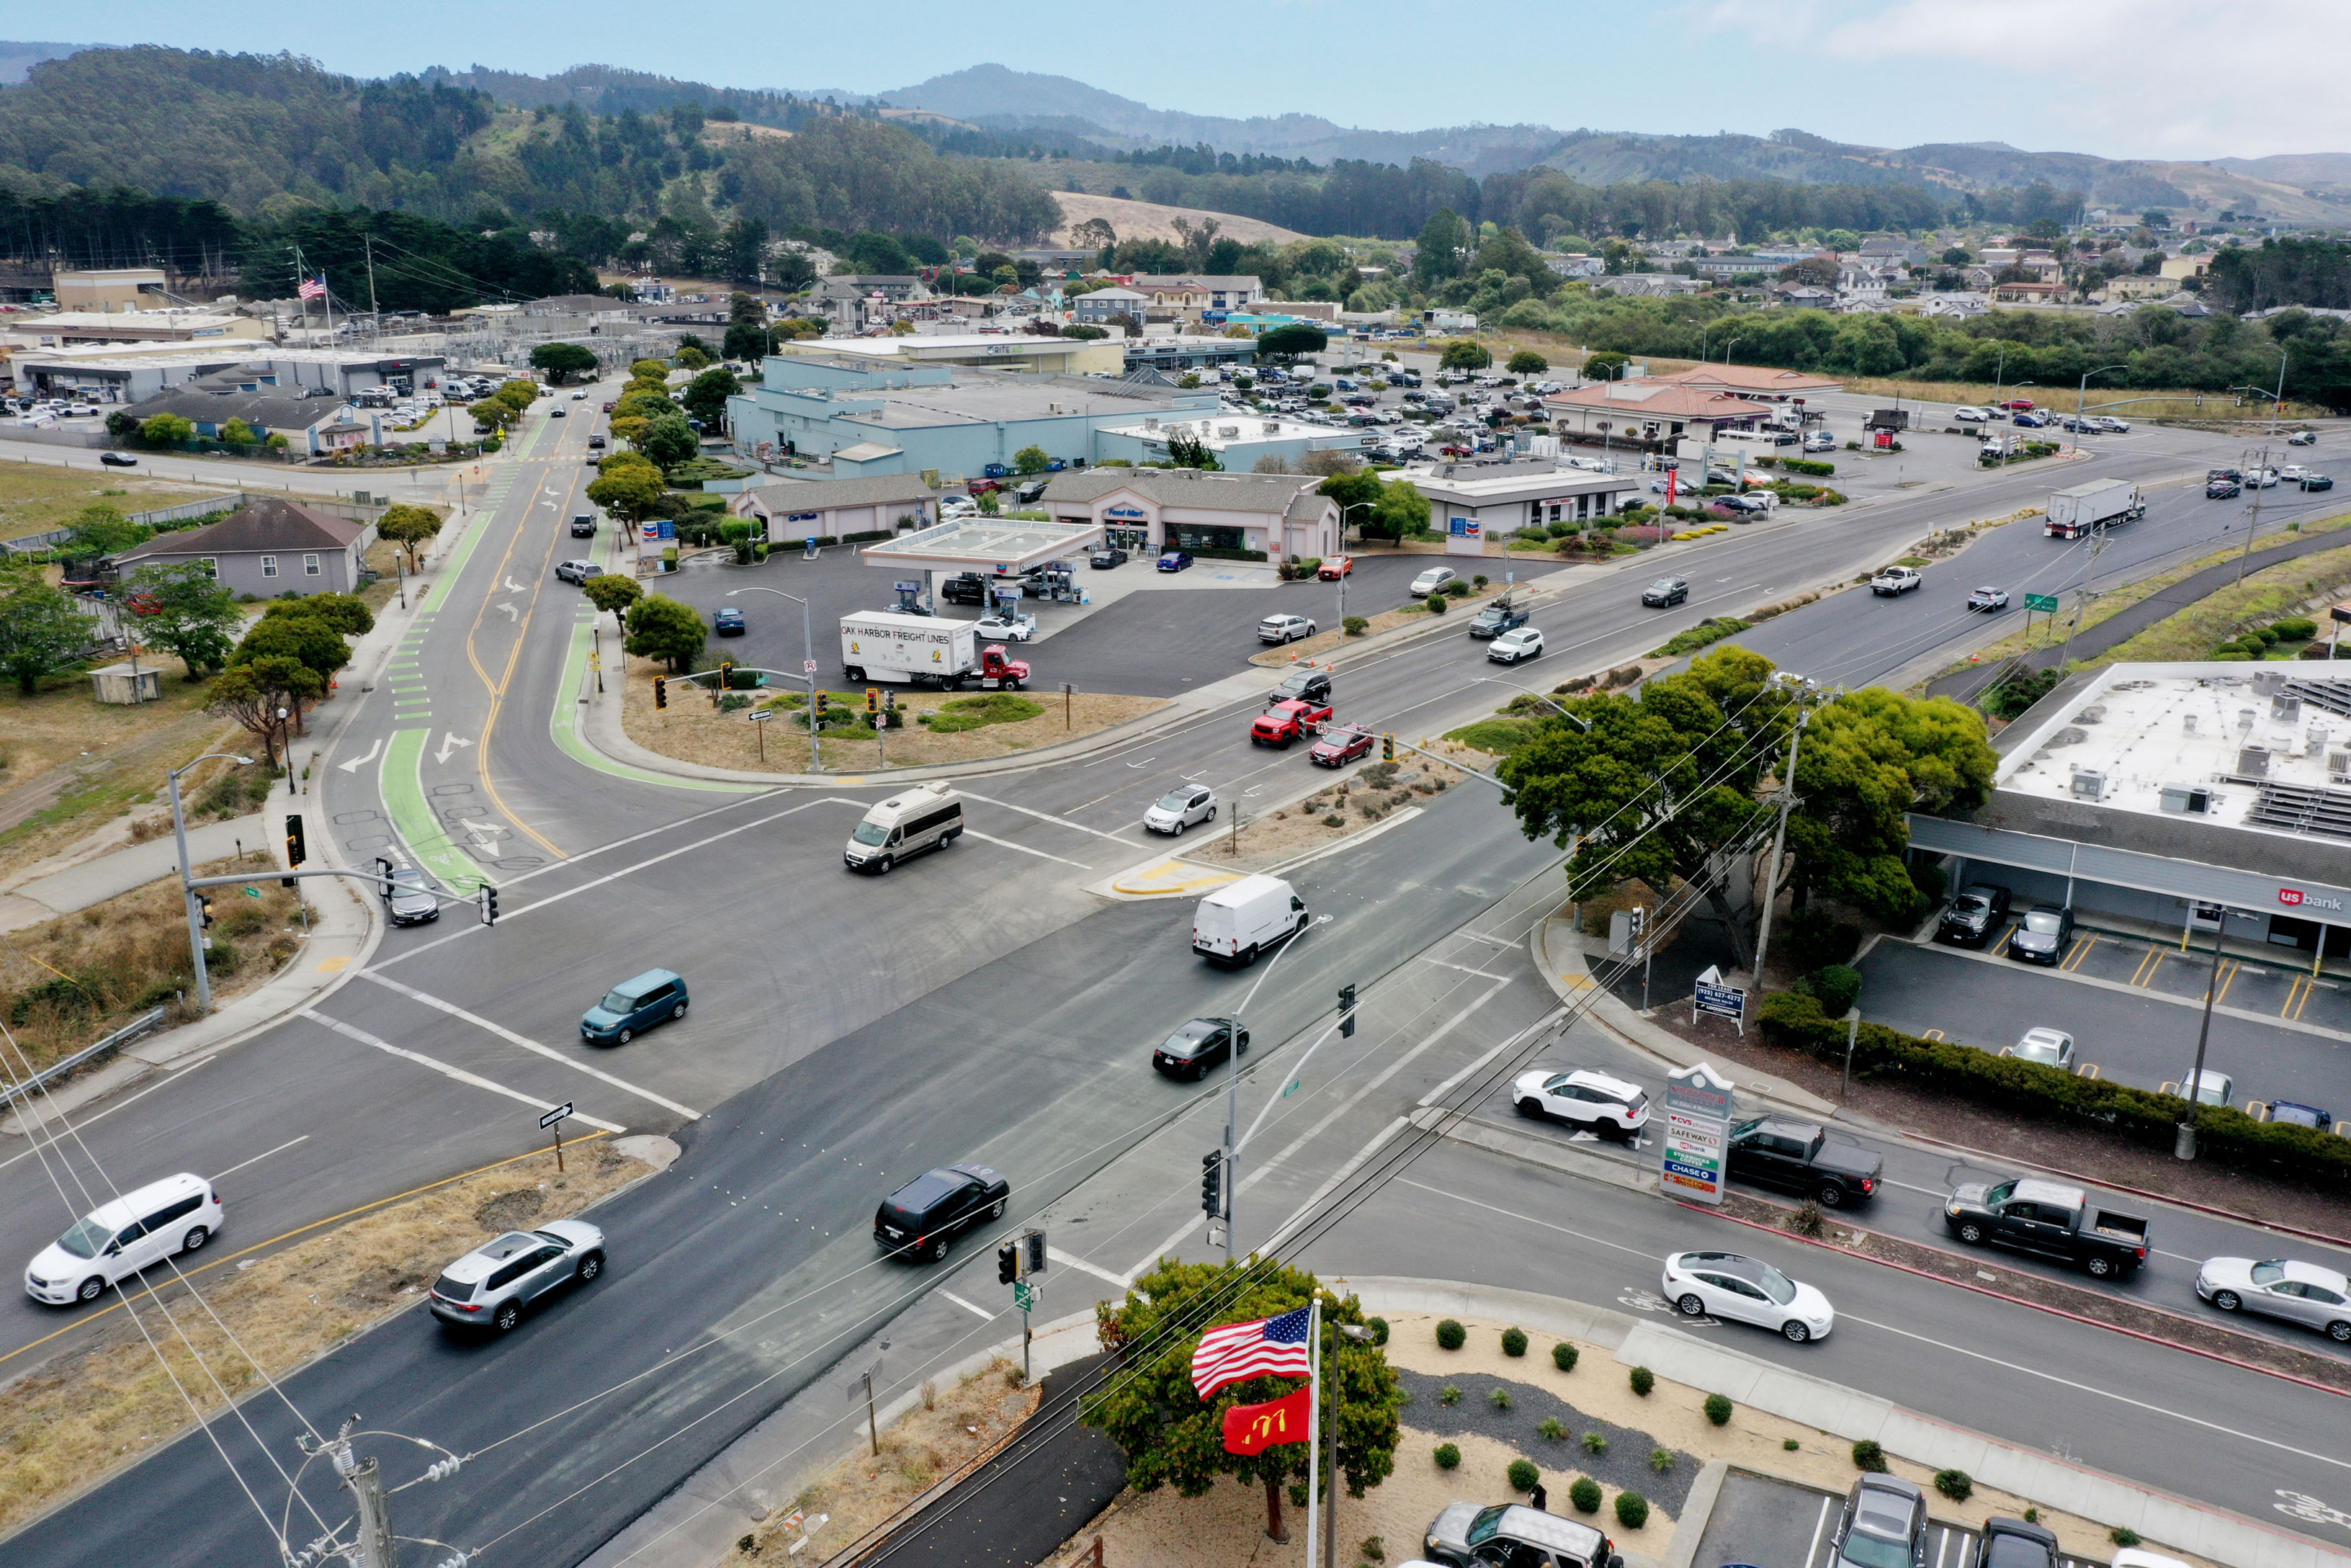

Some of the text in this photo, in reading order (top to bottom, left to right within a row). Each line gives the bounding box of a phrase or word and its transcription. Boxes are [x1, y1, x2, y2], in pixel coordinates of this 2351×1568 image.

[841, 626, 949, 645] OAK HARBOR FREIGHT LINES
[2280, 892, 2342, 910] us bank
[1698, 987, 1741, 1002] (925) 627-4272
[1677, 1117, 1721, 1134] CVS pharmacy
[1670, 1128, 1708, 1142] SAFEWAY
[1689, 1144, 1706, 1152] bank
[1673, 1151, 1710, 1165] STARBUCKS
[1679, 1156, 1703, 1167] COFFEE
[1672, 1164, 1701, 1177] CHASE
